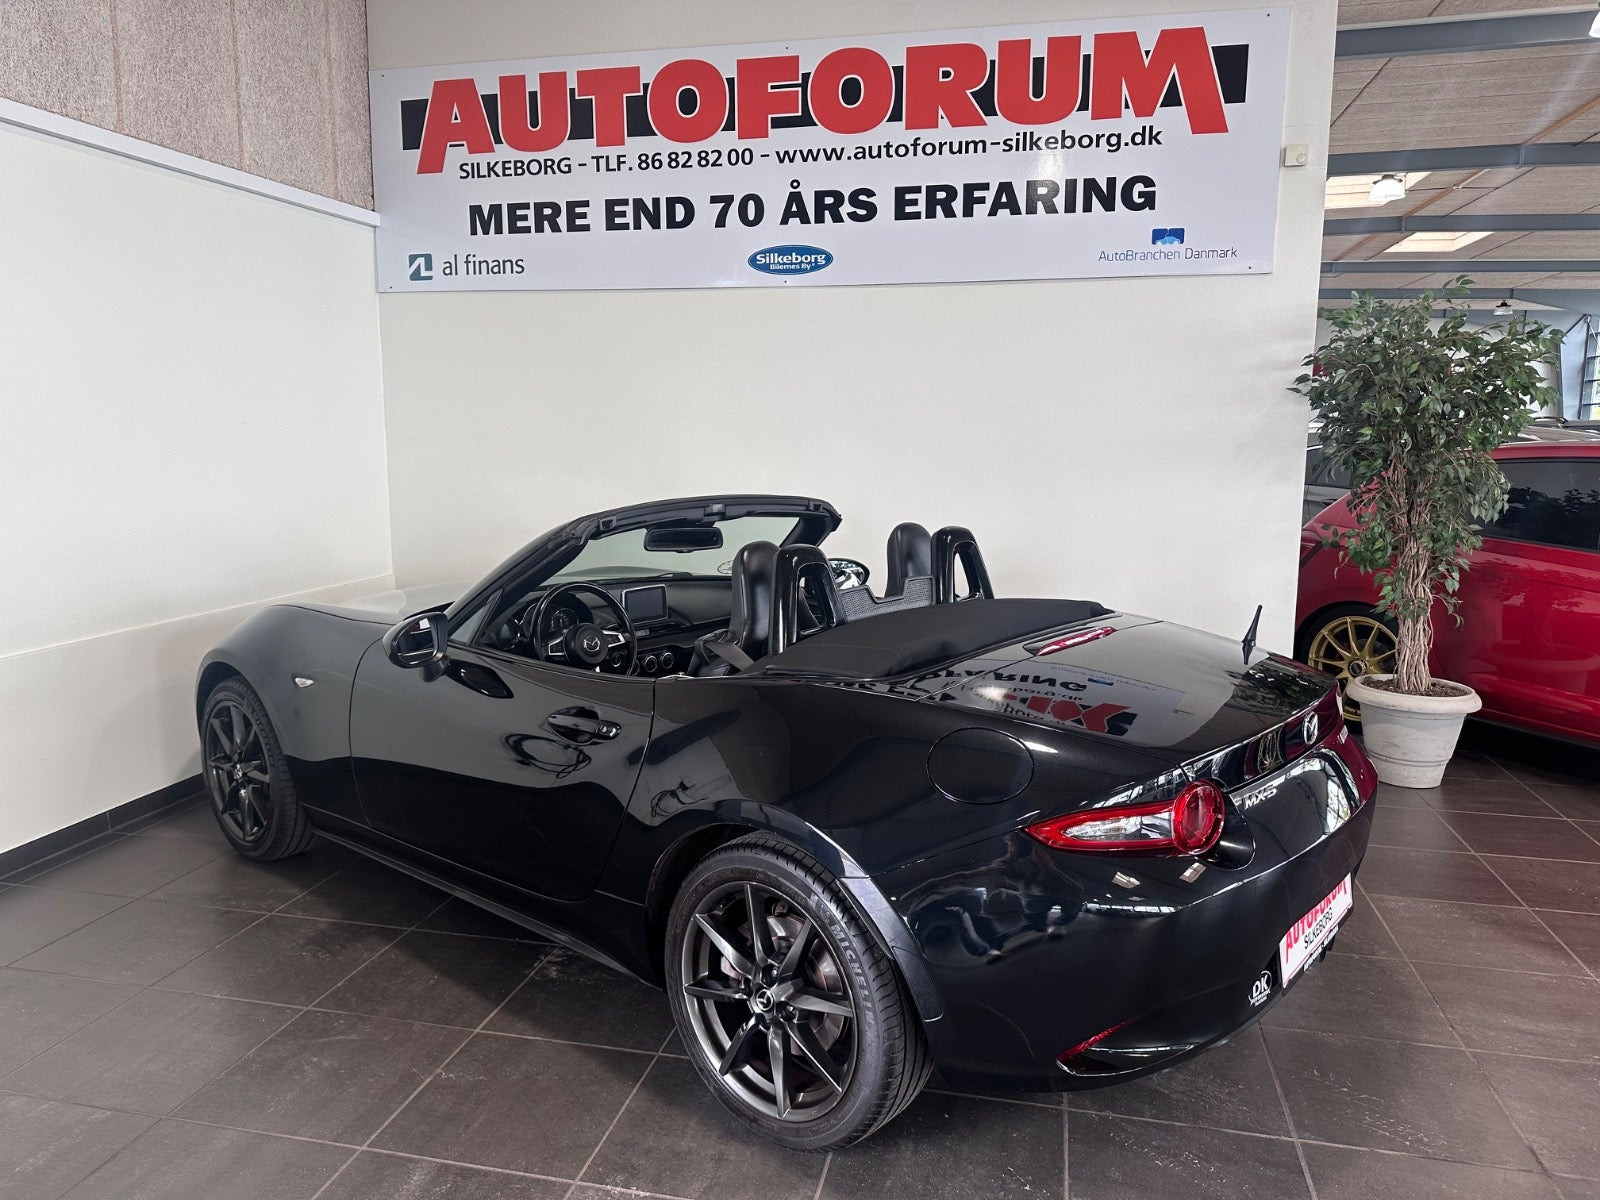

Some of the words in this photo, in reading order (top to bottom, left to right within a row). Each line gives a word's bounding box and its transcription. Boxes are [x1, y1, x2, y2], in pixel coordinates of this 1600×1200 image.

[416, 26, 1229, 174] AUTOFORUM
[459, 156, 573, 180] SILKEBORG
[591, 153, 633, 173] TLF.
[637, 152, 663, 171] 86
[667, 150, 693, 170] 82
[697, 149, 723, 168] 82
[727, 147, 754, 167] 00
[775, 125, 1164, 164] www.autoforum-silkeborg.dk
[469, 199, 592, 236] MERE
[605, 195, 696, 232] END
[709, 193, 765, 229] 70
[779, 178, 878, 227] ÅRS
[893, 174, 1158, 222] ERFARING
[442, 253, 459, 277] al
[464, 253, 525, 276] finans
[756, 252, 827, 265] Silkeborg
[1098, 248, 1181, 262] AutoBranchen
[1184, 247, 1239, 260] Danmark
[1303, 906, 1333, 950] SILKEBORG
